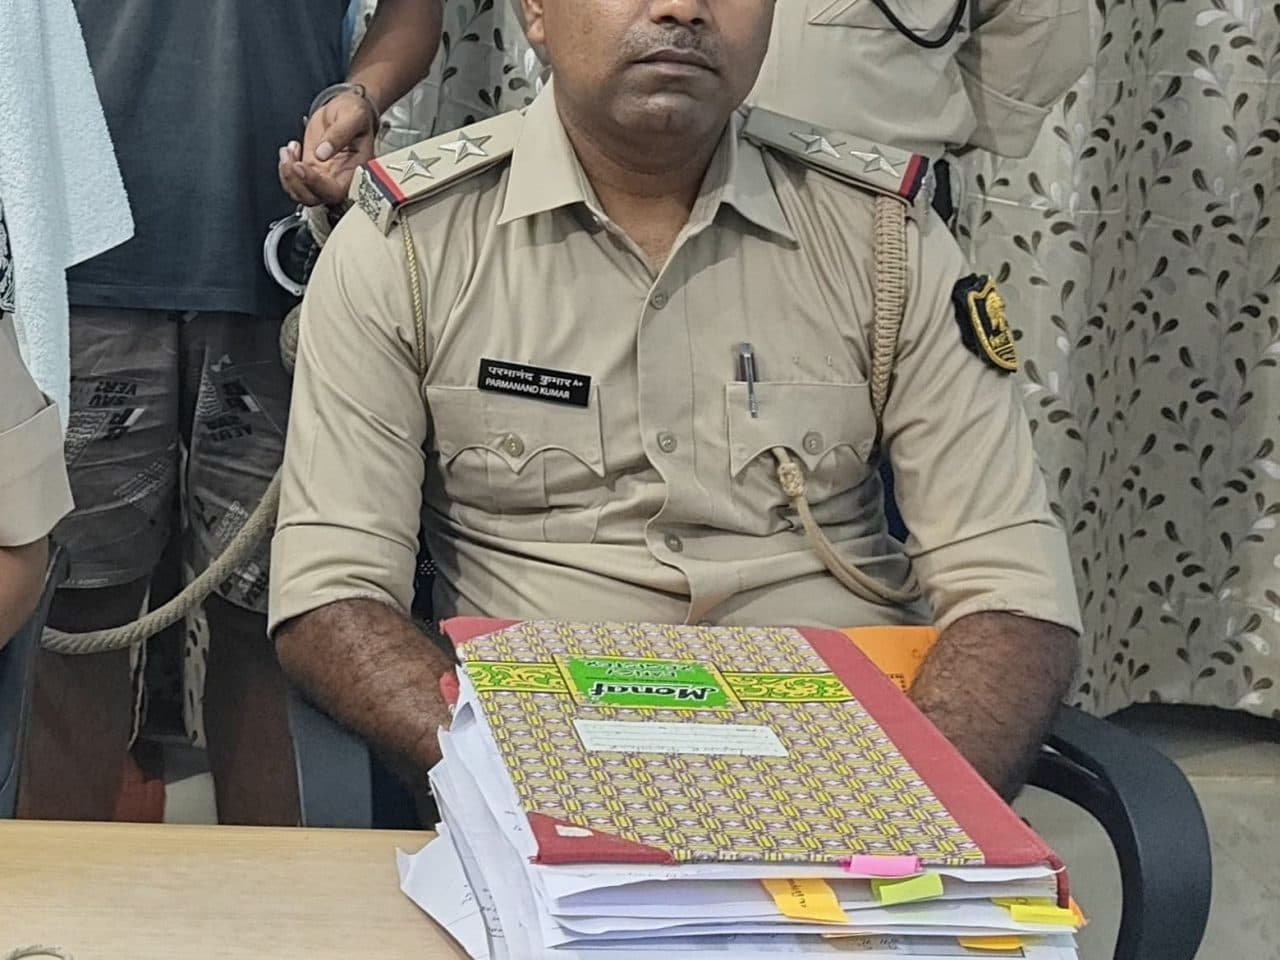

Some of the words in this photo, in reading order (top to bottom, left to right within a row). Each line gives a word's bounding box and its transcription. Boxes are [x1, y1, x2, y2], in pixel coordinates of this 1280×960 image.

[485, 377, 539, 394] PARMANAND
[540, 386, 570, 400] KUMAR
[539, 374, 572, 388] कुमार
